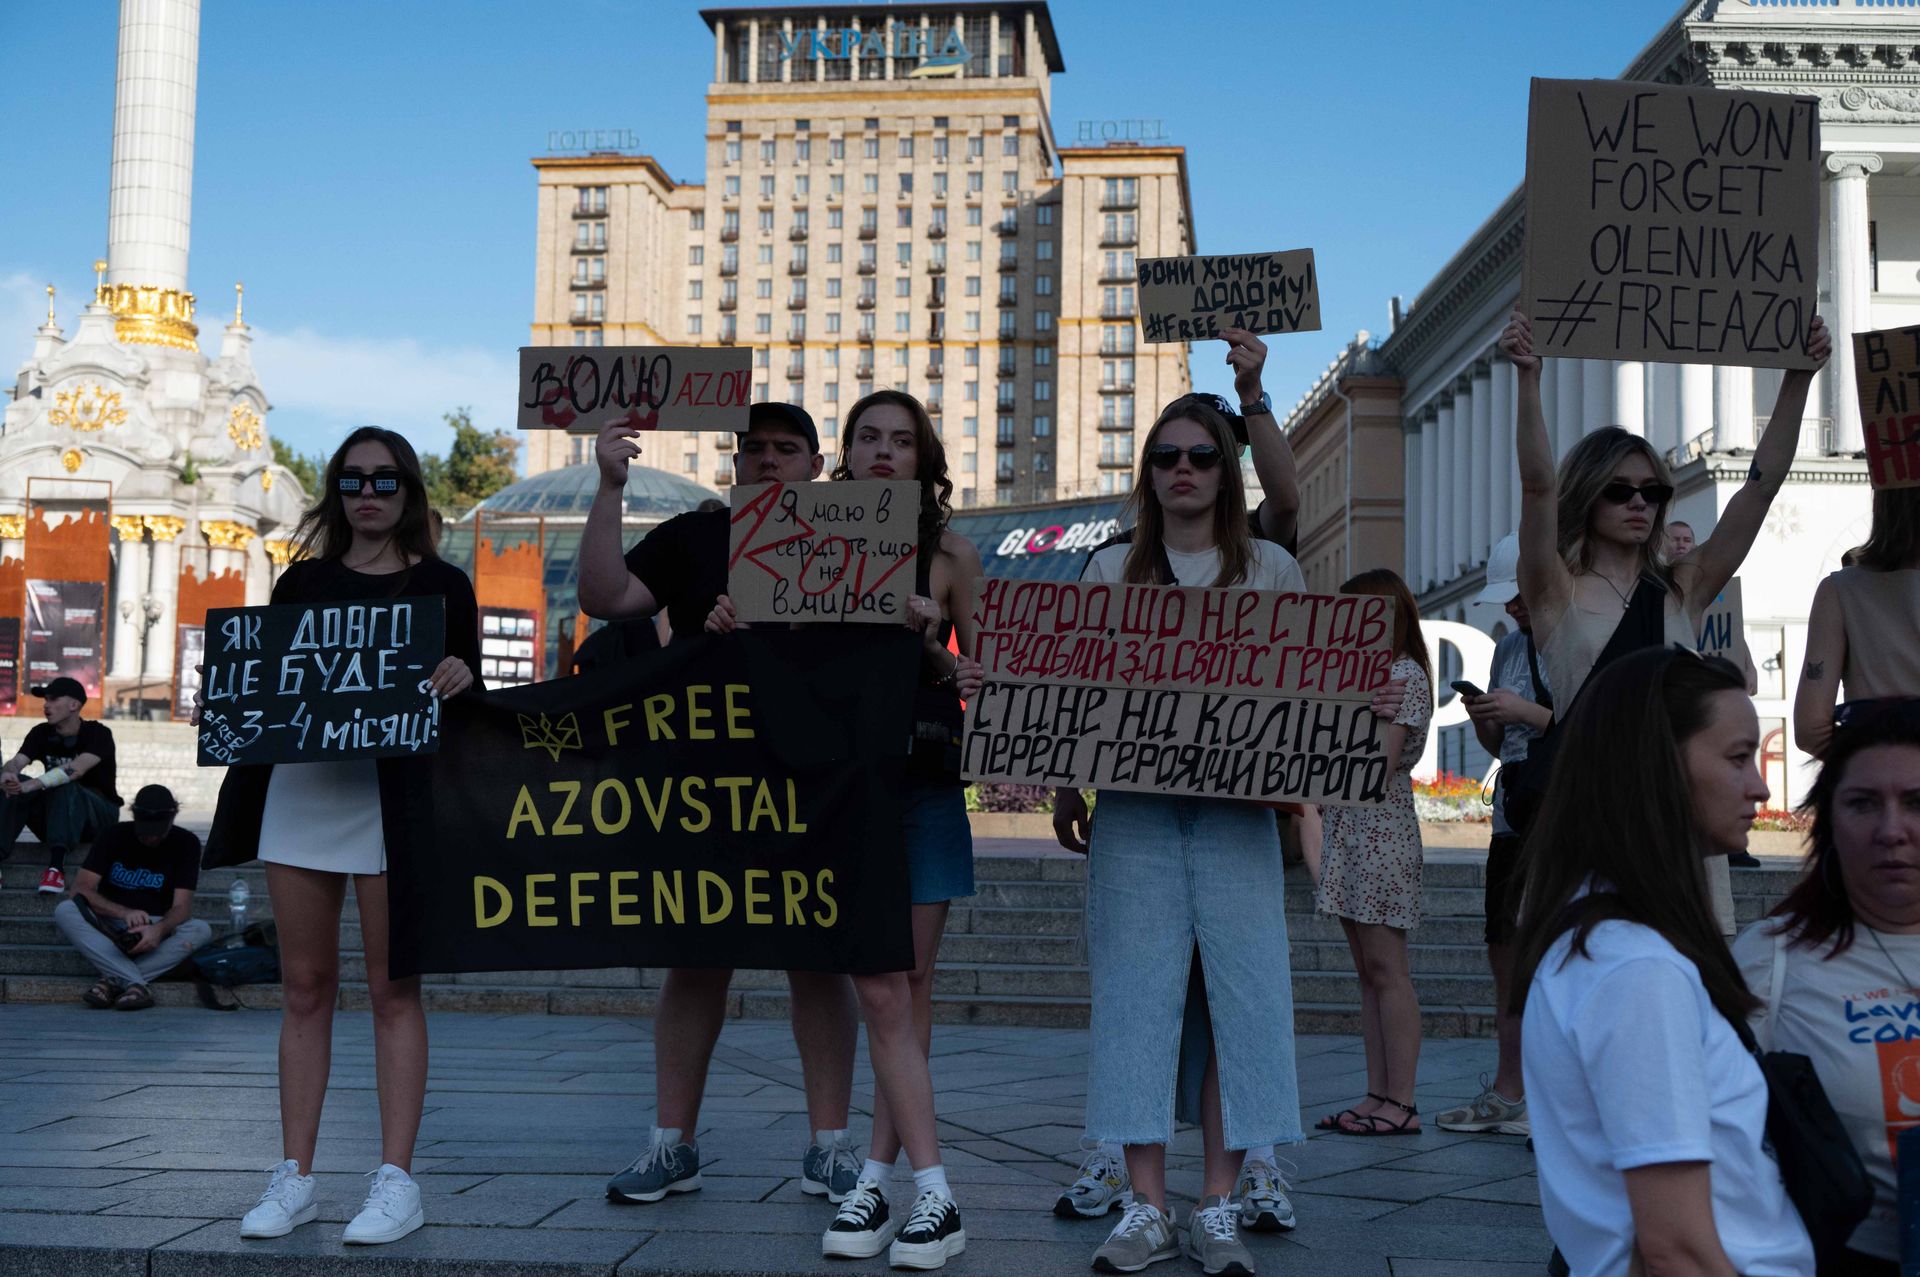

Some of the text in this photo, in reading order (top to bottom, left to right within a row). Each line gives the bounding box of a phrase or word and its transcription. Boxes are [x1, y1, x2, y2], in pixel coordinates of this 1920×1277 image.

[777, 21, 968, 60] УКРАЇНА
[546, 129, 640, 151] ГОТЕЛЬ
[1077, 119, 1169, 141] HOTEL
[1578, 92, 1819, 161] WE WON'T
[1591, 159, 1782, 217] FORGET
[1138, 255, 1283, 288] ВОНИ ХОЧУТЬ
[1591, 224, 1803, 283] OLENIVKA
[1191, 262, 1312, 313] ДОДОМУ!
[1146, 303, 1305, 342] #FREE AZOV
[1535, 280, 1818, 356] #FREEAZOV
[524, 354, 752, 414] ВОЛЮ AZOV
[775, 488, 892, 526] Я маю в
[776, 532, 837, 571] серці
[996, 517, 1118, 558] GLOBUS
[820, 565, 844, 581] не
[221, 603, 412, 652] ЯК ДОВГО
[1270, 592, 1386, 649] СТАВ
[208, 659, 262, 704] ЩЕ
[974, 631, 1118, 682] ГРУДЬМИ
[603, 684, 755, 746] FREE
[1116, 690, 1182, 742] НА
[199, 731, 241, 764] AZOV
[1261, 752, 1388, 803] ВОРОГА
[506, 776, 807, 839] AZOVSTAL
[474, 868, 838, 928] DEFENDERS
